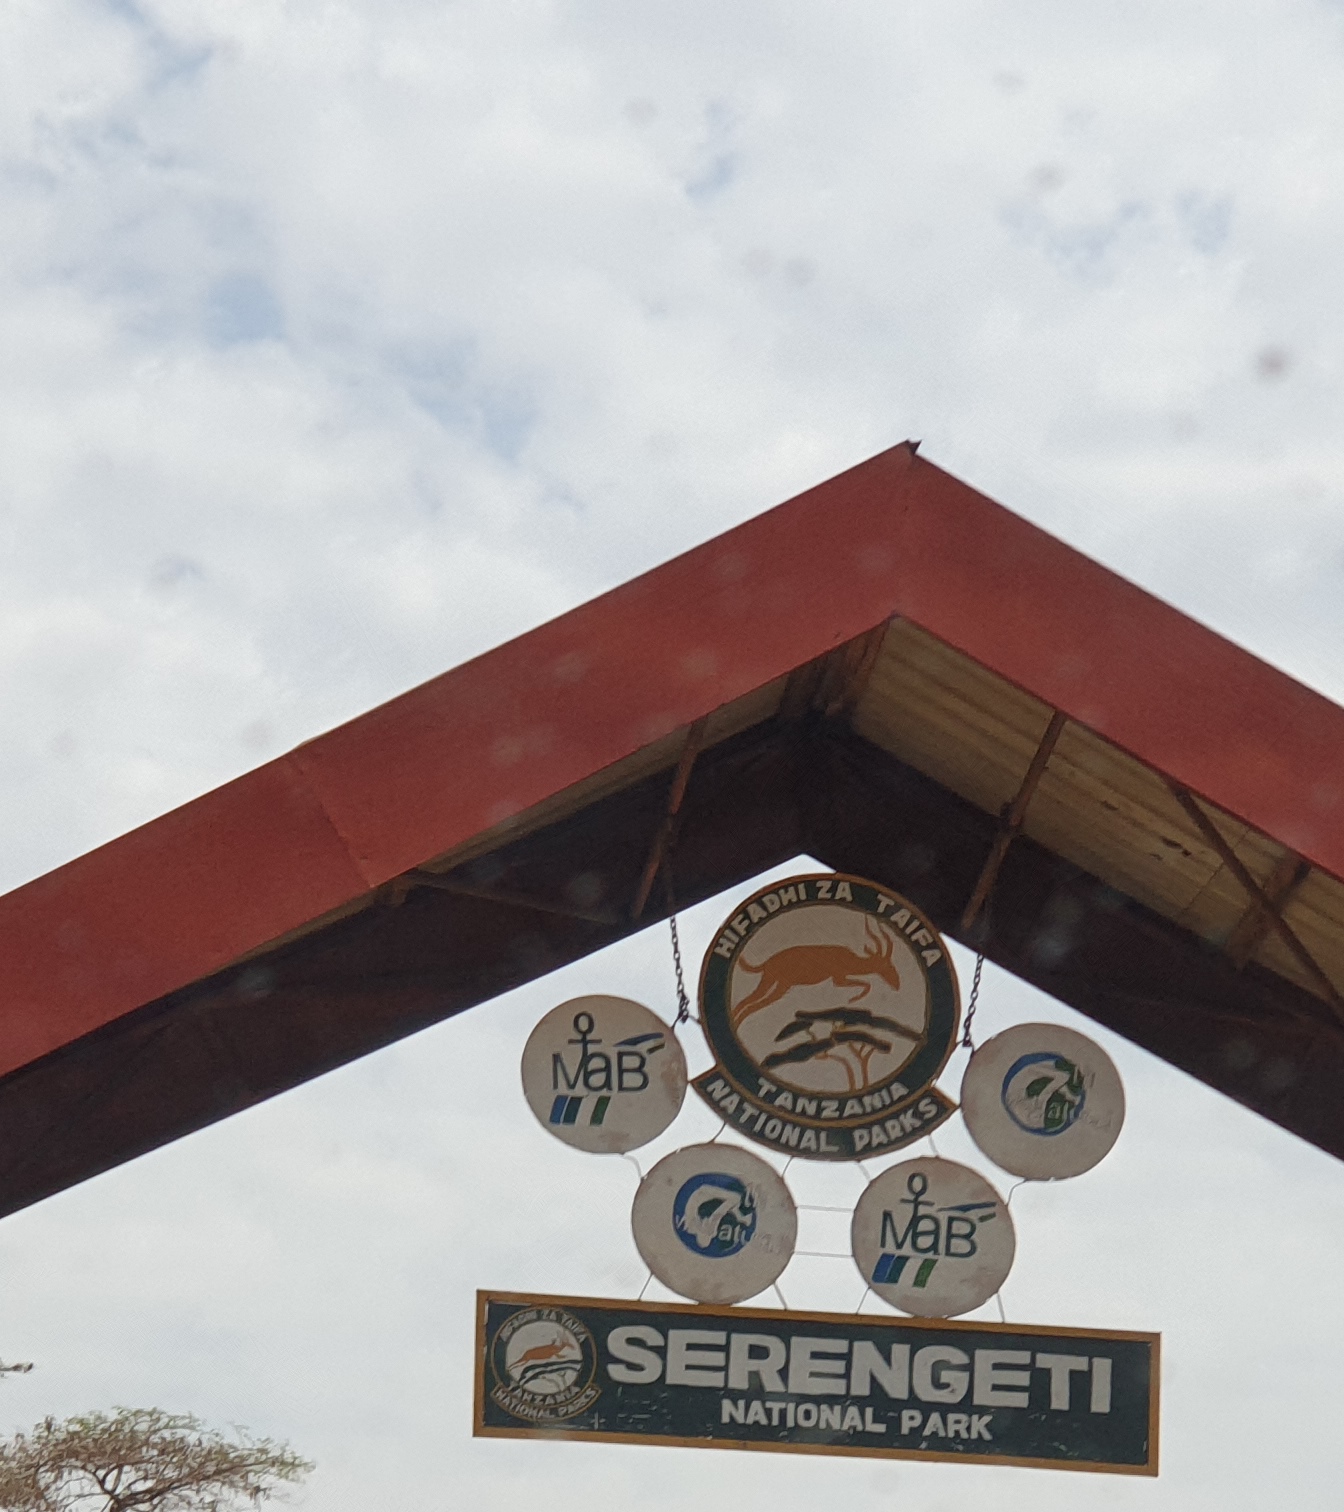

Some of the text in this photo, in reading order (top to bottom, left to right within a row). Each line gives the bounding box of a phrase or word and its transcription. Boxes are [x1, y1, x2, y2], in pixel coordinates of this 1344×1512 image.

[713, 880, 943, 968] HIFADHI ZA TAIFA
[706, 1078, 840, 1153] NATIONAL
[852, 1098, 939, 1151] PARKS
[757, 1076, 910, 1119] TANZANIA
[605, 1325, 1113, 1414] SERENGETI
[720, 1398, 994, 1442] NATIONAL PARK
